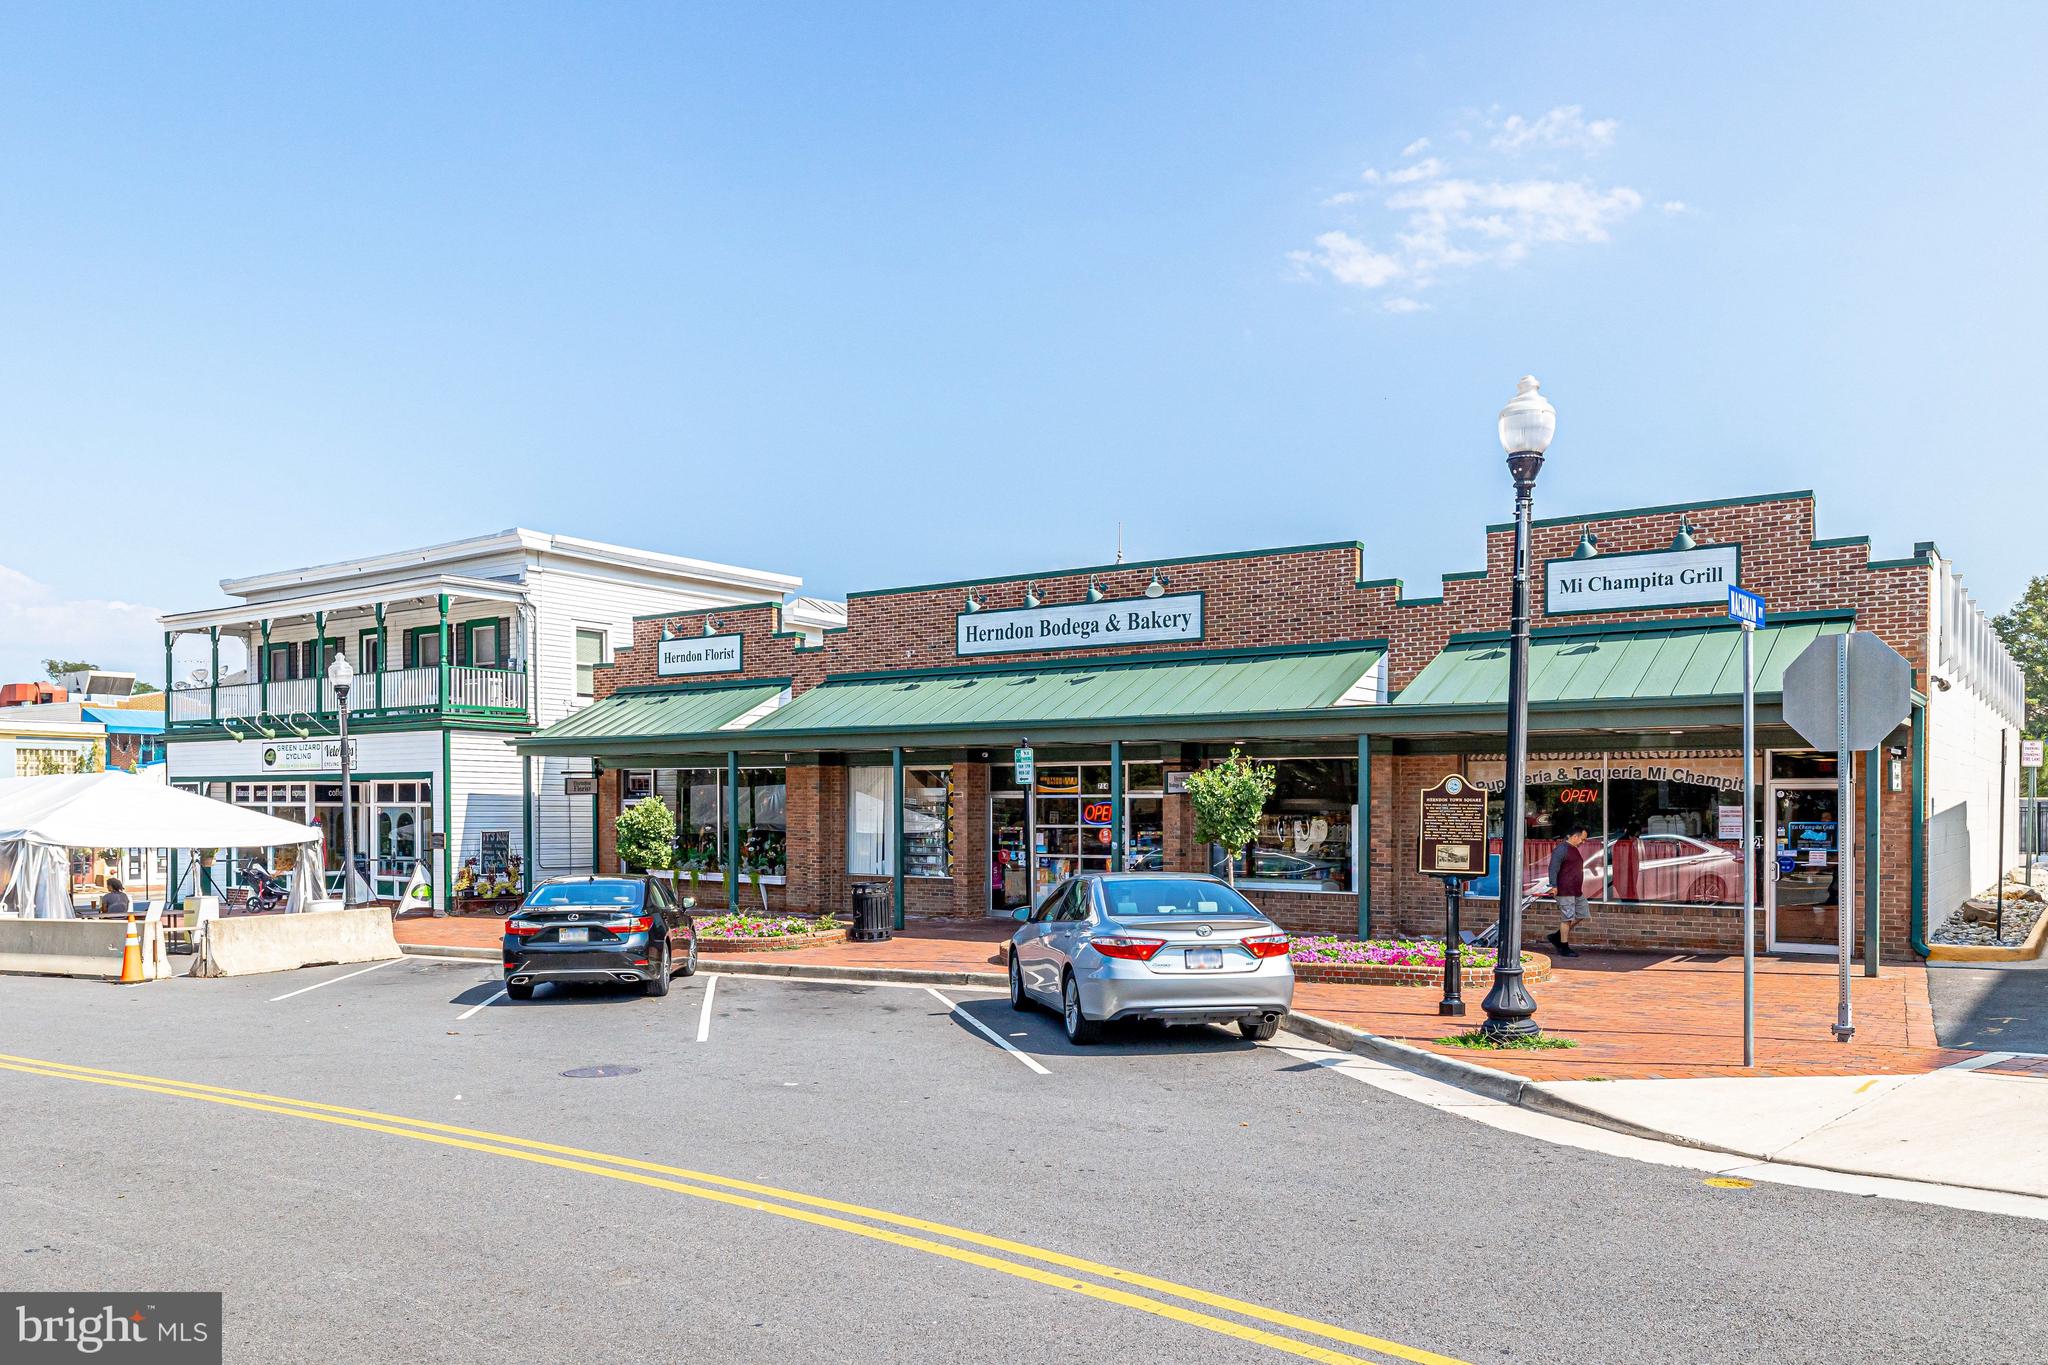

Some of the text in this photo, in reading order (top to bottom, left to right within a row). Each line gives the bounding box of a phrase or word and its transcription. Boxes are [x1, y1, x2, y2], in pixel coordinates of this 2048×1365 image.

[1559, 566, 1724, 595] Mi Champita Grill
[965, 610, 1192, 643] Herndon Bodega & Bakery
[663, 647, 735, 664] Herndon Florist
[276, 743, 321, 752] GREEN LIZARD
[285, 752, 312, 760] CYCLING
[1475, 766, 1746, 792] Pupería & Taquería Mi Champit
[1560, 788, 1599, 804] OPEN
